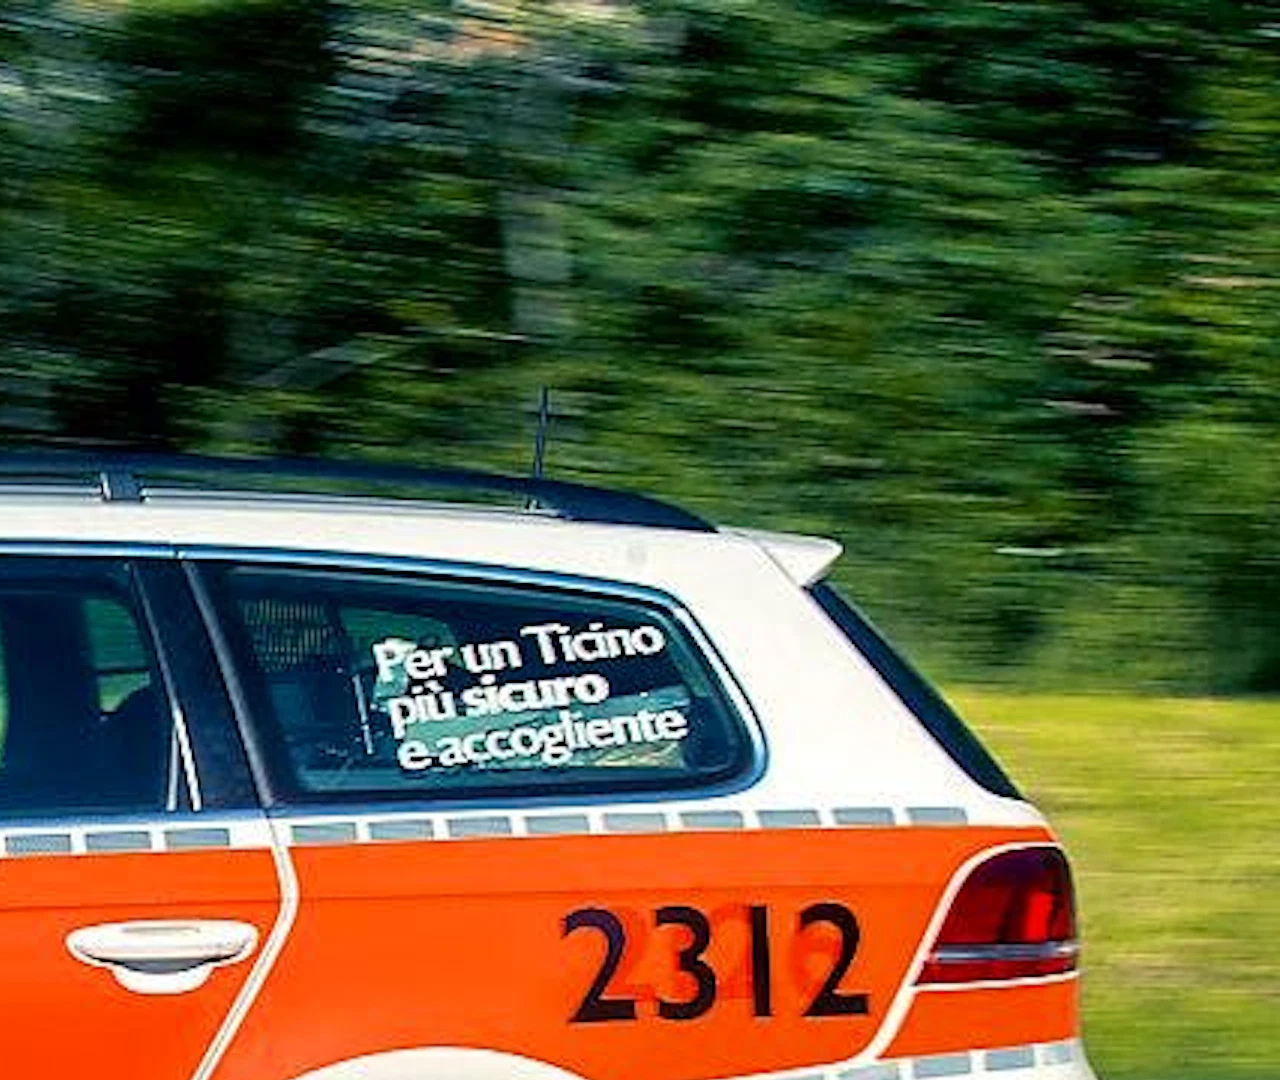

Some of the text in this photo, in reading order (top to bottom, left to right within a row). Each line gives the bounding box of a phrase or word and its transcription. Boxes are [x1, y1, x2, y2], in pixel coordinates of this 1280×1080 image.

[372, 622, 666, 683] Per un Ticino
[387, 673, 609, 739] più sicuro
[397, 709, 688, 769] e accogliente
[561, 902, 871, 1023] 2312
